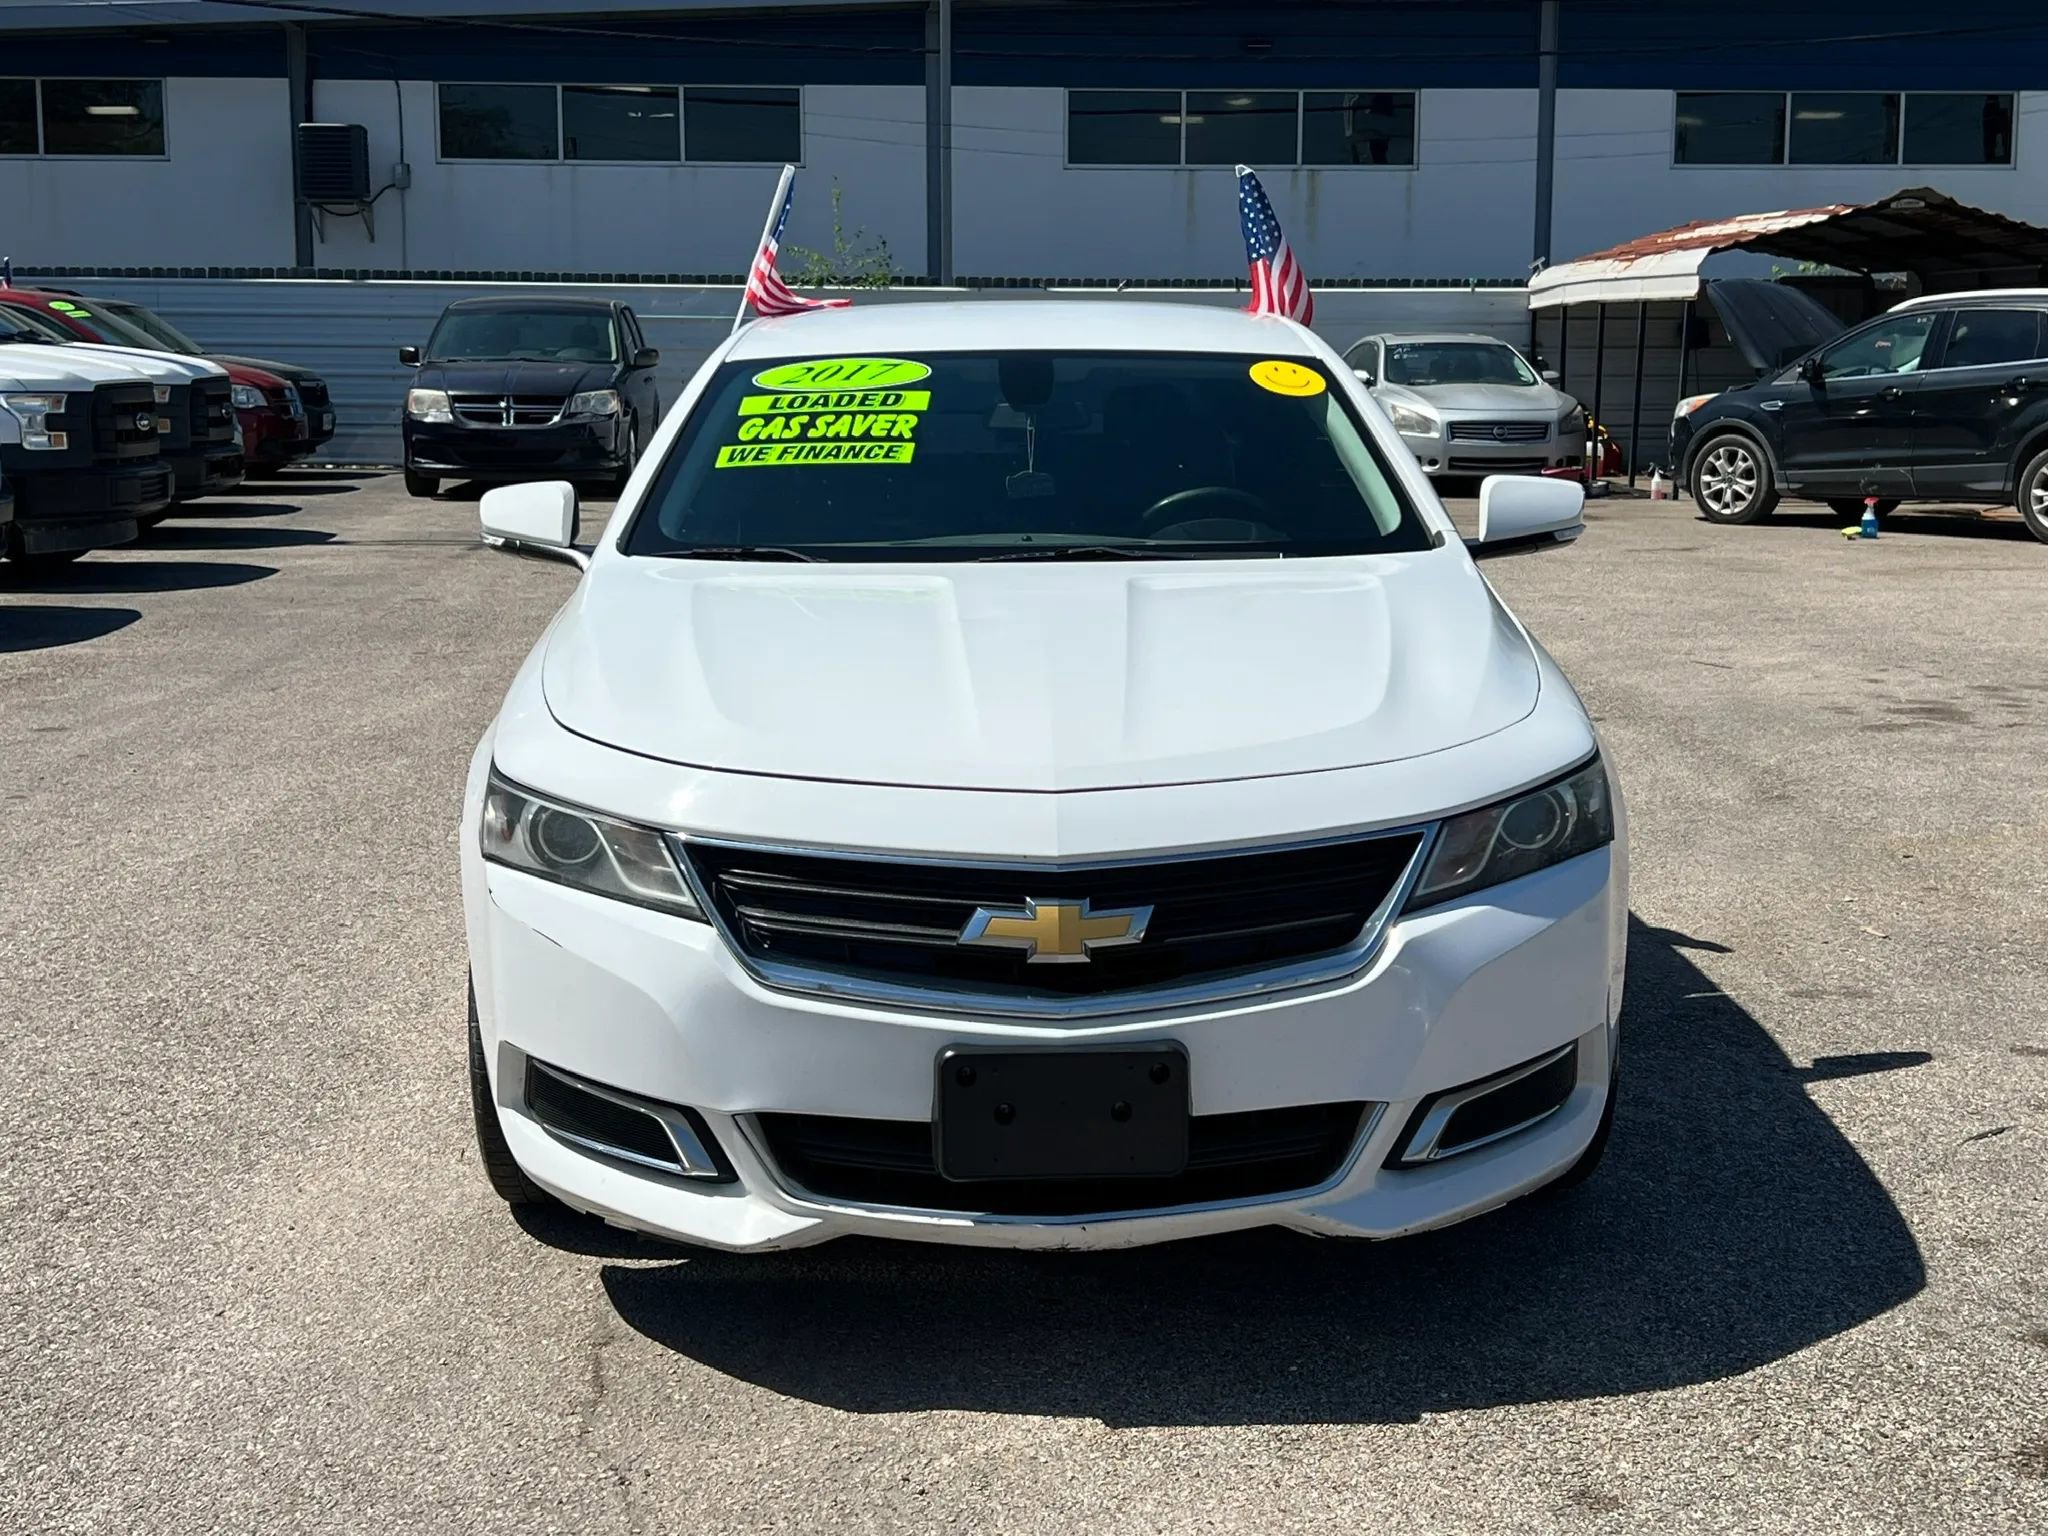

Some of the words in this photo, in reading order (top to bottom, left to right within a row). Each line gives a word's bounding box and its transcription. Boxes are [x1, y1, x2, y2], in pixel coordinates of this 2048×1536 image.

[779, 363, 904, 385] 2017
[768, 393, 904, 410] LOADED
[738, 415, 809, 441] GAS
[807, 414, 918, 438] SAVER
[727, 447, 774, 463] WE
[776, 444, 904, 461] FINANCE
